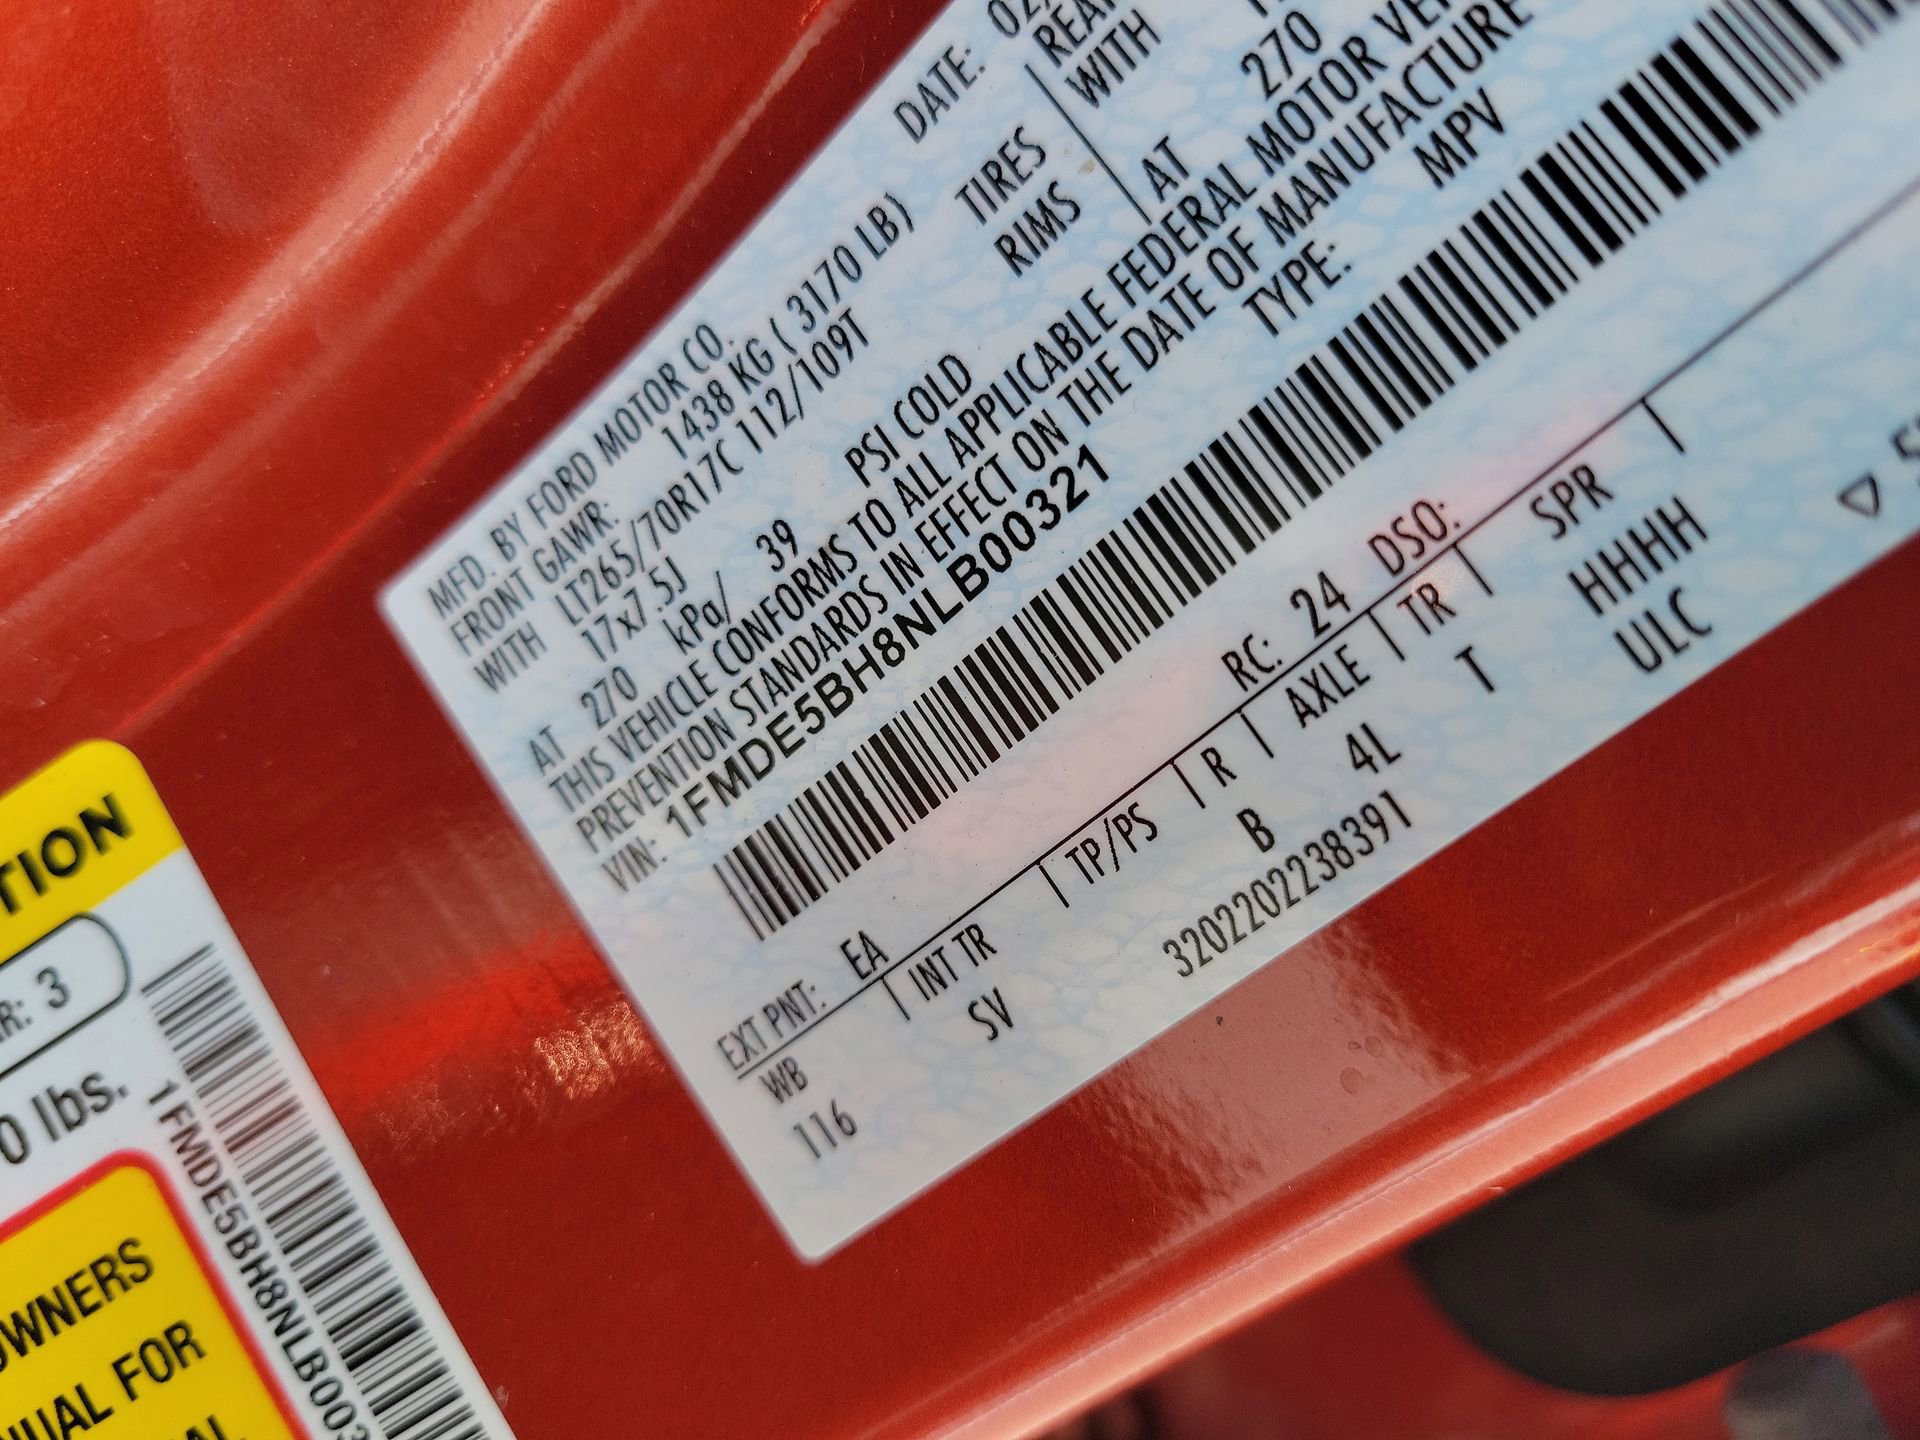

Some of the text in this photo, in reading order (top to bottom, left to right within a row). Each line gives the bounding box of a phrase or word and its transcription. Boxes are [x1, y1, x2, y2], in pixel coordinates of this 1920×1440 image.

[1032, 0, 1116, 69] REA
[1064, 8, 1161, 109] WITH
[893, 44, 988, 146] DATE:
[1140, 11, 1322, 204] AT 270
[954, 124, 1048, 227] TIRES
[1240, 85, 1507, 339] TYPE: MPV
[993, 179, 1083, 280] RIMS
[661, 378, 735, 460] 1438
[727, 336, 776, 396] KG
[786, 243, 865, 334] 3170
[854, 191, 916, 262] LB)
[428, 323, 736, 620] MFD. BY FORD MOTOR CO.
[548, 745, 618, 814] THIS
[606, 658, 719, 765] VEHICLE
[712, 533, 859, 679] CONFORMS
[846, 497, 898, 553] TO
[892, 451, 953, 520] ALL
[943, 287, 1119, 471] APPLICABLE
[1106, 161, 1258, 310] FEDERAL
[1245, 35, 1389, 179] MOTOR
[554, 307, 870, 627] LT265/70R17C 112/109T
[843, 353, 973, 489] PSI COLD
[575, 704, 738, 855] PREVENTION
[728, 573, 889, 728] STANDARDS
[879, 541, 926, 597] IN
[914, 451, 1019, 565] EFFECT
[1011, 408, 1072, 473] ON
[1056, 351, 1134, 428] THE
[1120, 272, 1218, 373] DATE
[1206, 225, 1261, 293] OF
[1366, 498, 1462, 578] DSO:
[1529, 462, 1616, 540] SPR
[450, 500, 620, 658] FRONT GAWR:
[1565, 495, 1709, 618] HHHH
[473, 620, 549, 695] WITH
[529, 518, 801, 778] AT 270 kPa/ 39
[581, 555, 689, 664] 17x7.5J
[1220, 571, 1353, 692] RC: 24
[1396, 580, 1459, 636] TR
[1612, 585, 1714, 674] ULC
[602, 443, 1111, 894] VIN: 1FMDE5BH8NLB00321
[1284, 643, 1371, 729] AXLE
[1453, 643, 1497, 695] T
[1200, 745, 1238, 788] R
[1345, 722, 1402, 776] 4L
[1064, 801, 1159, 886] TP/PS
[1236, 807, 1276, 853] B
[1161, 789, 1412, 979] 3202202238391
[36, 966, 71, 1009] 3
[716, 930, 890, 1072] EXT PNT: EA
[907, 922, 999, 1001] INT TR
[967, 985, 1015, 1042] SV
[32, 1071, 129, 1142] lbs.
[759, 1055, 810, 1105] WB
[793, 1098, 859, 1160] 116
[111, 1319, 208, 1402] FOR
